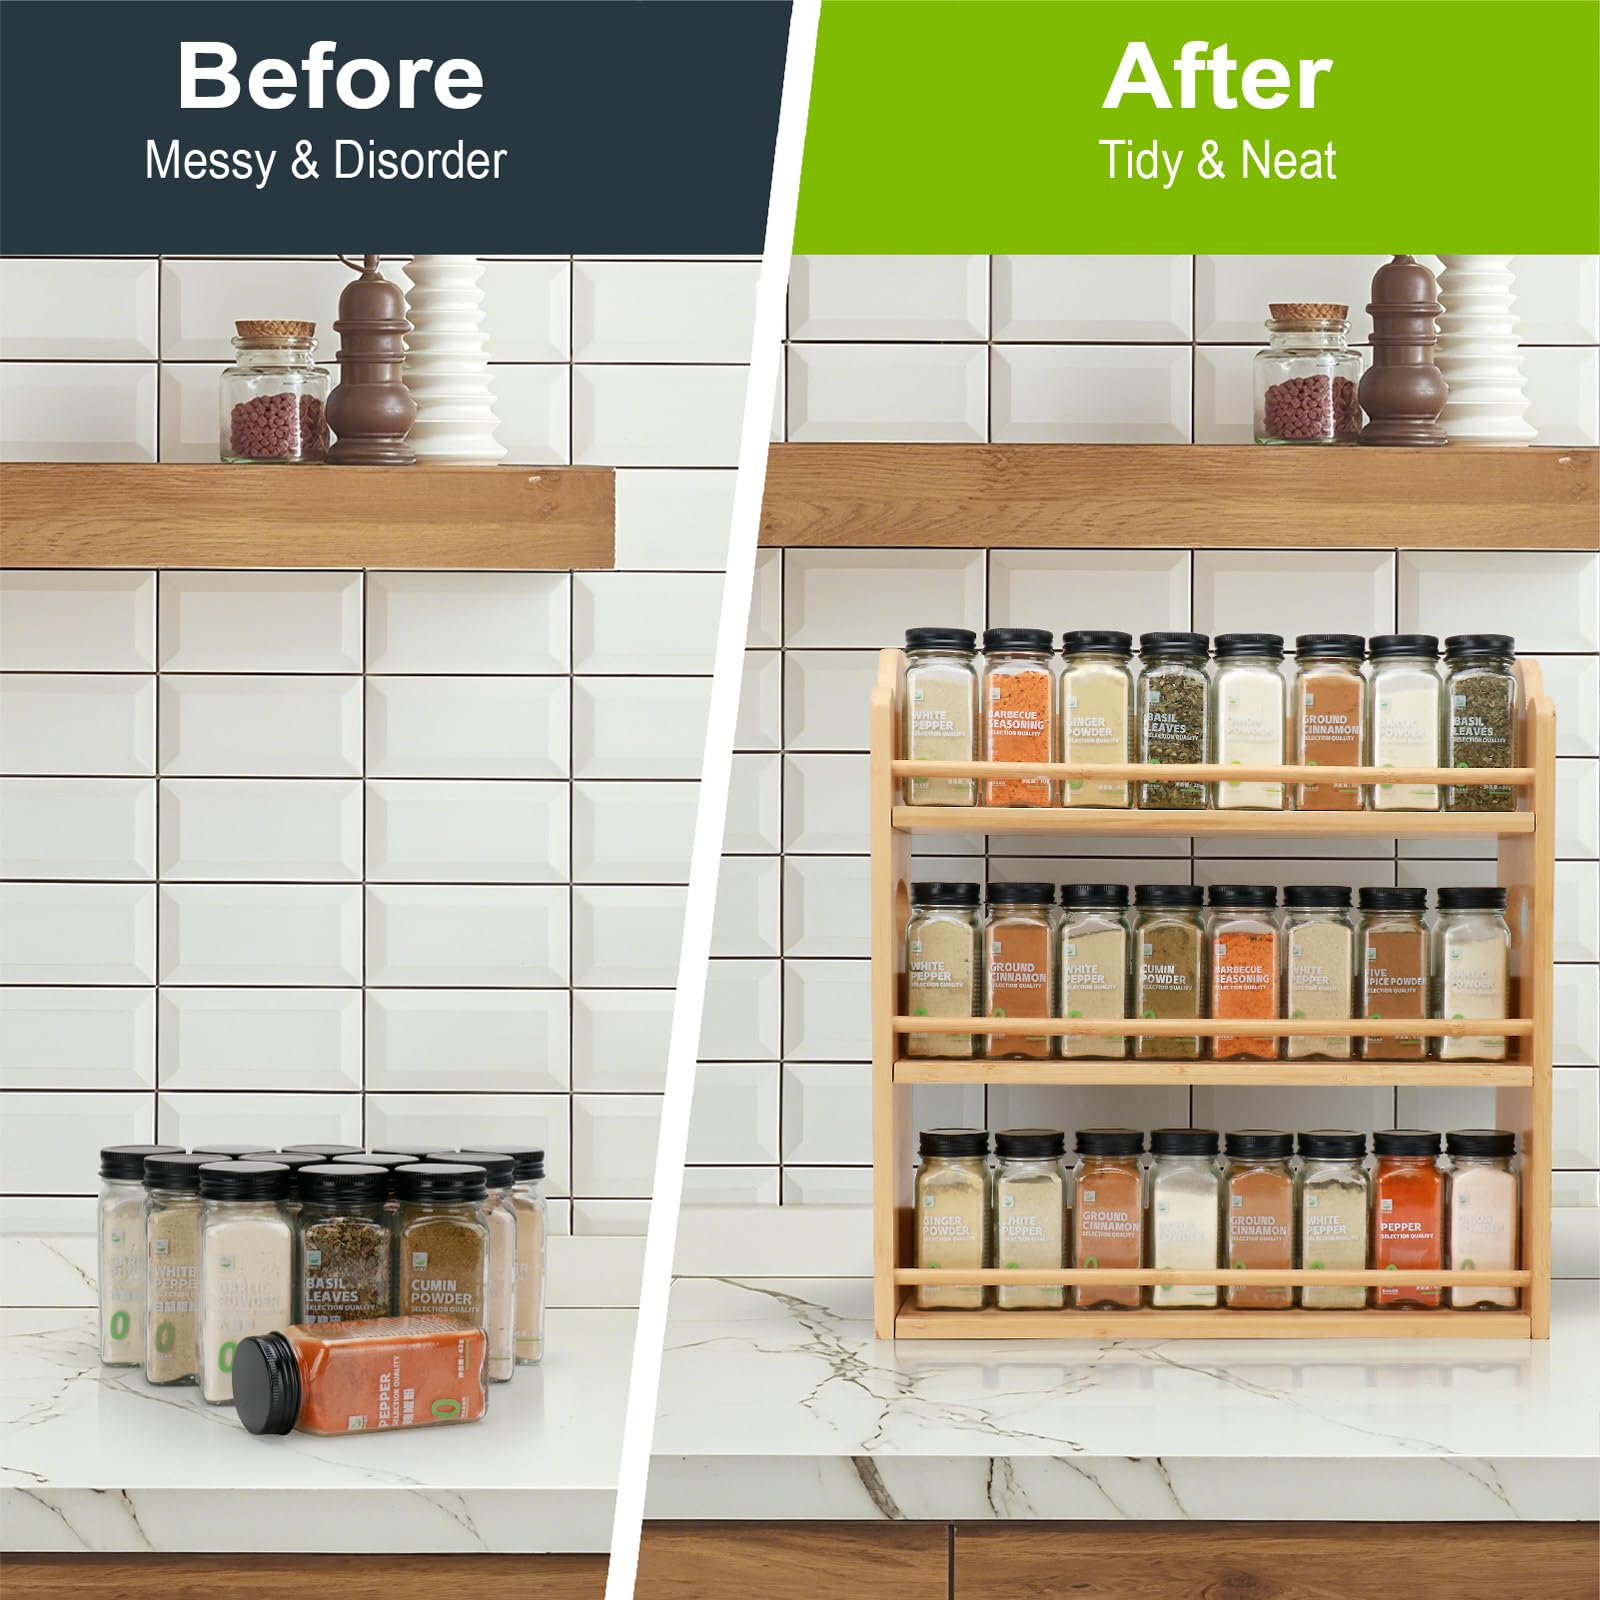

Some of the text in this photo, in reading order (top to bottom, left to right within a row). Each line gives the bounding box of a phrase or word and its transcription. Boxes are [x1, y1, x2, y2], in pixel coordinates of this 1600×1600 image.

[912, 711, 947, 720] WHITE
[988, 710, 1037, 720] BARBECUE
[1146, 712, 1178, 723] BASIL
[1302, 714, 1348, 724] GROUND
[912, 720, 954, 731] PEPPER
[988, 719, 1045, 731] SEASONING
[1067, 716, 1105, 727] GINGER
[1453, 716, 1485, 727] BASIL
[1067, 726, 1113, 737] POWDER
[1146, 722, 1186, 733] LEAVES
[1302, 724, 1360, 735] CINNAMON
[1453, 726, 1494, 737] LEAVES
[910, 961, 945, 971] WHITE
[991, 962, 1035, 972] GROUND
[1065, 964, 1098, 974] WHITE
[1142, 964, 1175, 974] CUMIN
[1215, 965, 1263, 974] BARBECUE
[912, 970, 952, 981] PEPPER
[991, 971, 1047, 983] CINNAMON
[1065, 973, 1105, 984] PEPPER
[1142, 974, 1186, 985] POWDER
[1215, 974, 1270, 984] SEASONING
[923, 1216, 961, 1226] GINGER
[1083, 1211, 1128, 1221] GROUND
[1231, 1215, 1276, 1225] GROUND
[1306, 1215, 1340, 1225] WHITE
[923, 1225, 969, 1236] POWDER
[1002, 1225, 1043, 1236] PEPPER
[1083, 1221, 1139, 1232] CINNAMON
[1231, 1225, 1287, 1235] CINNAMON
[1307, 1225, 1347, 1235] PEPPER
[1380, 1222, 1422, 1232] PEPPER
[153, 1279, 198, 1289] PEPPE
[306, 1278, 346, 1289] BASIL
[411, 1279, 456, 1291] CUMIN
[305, 1291, 359, 1302] LEAVES
[411, 1293, 472, 1305] POWDER
[379, 1372, 391, 1428] PEPPER
[391, 1388, 400, 1426] SELECTION
